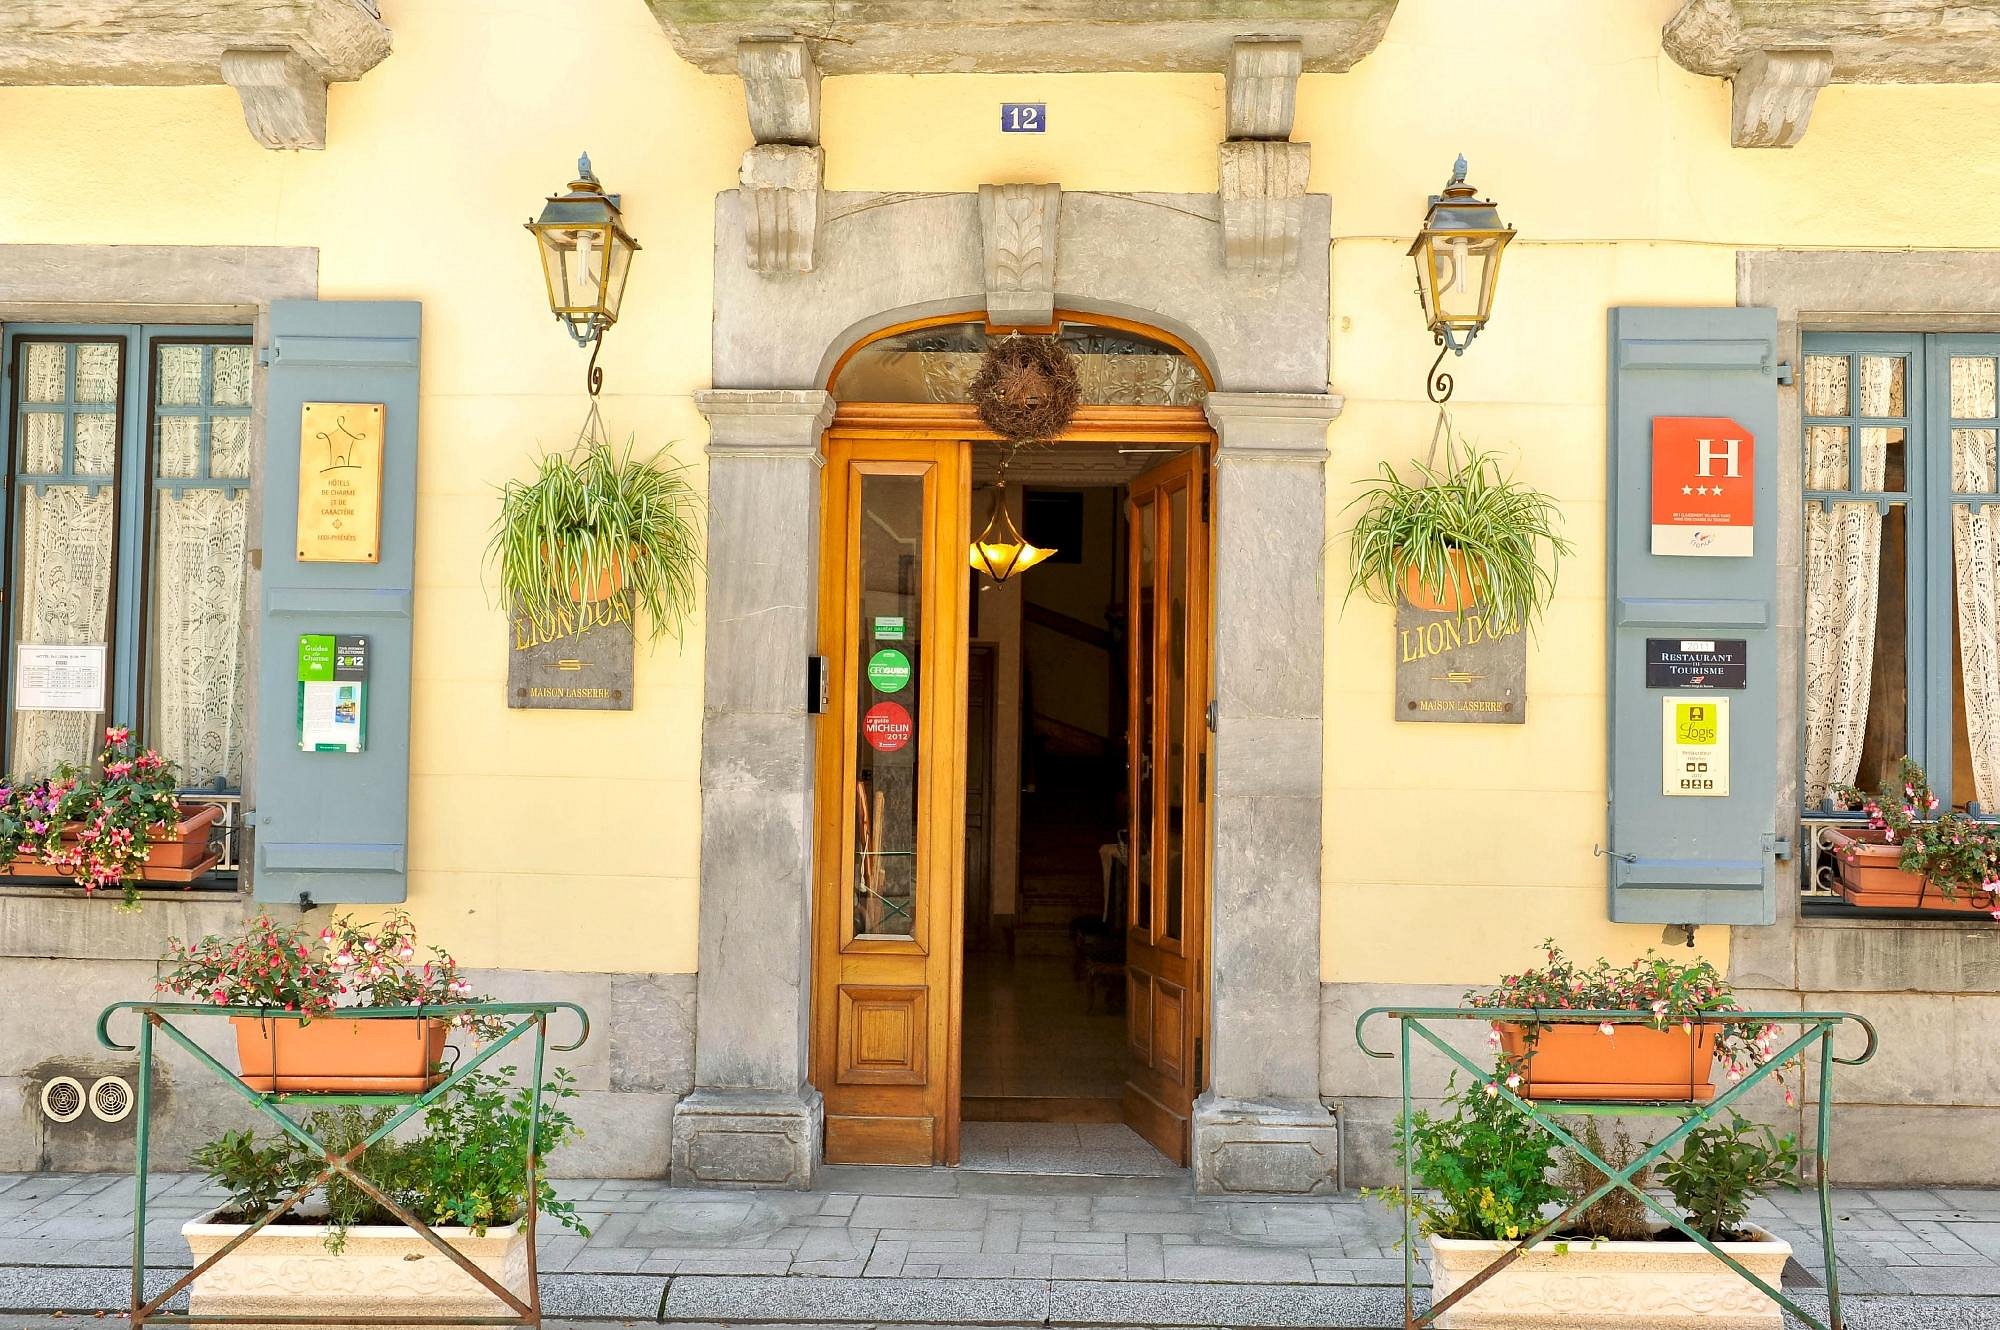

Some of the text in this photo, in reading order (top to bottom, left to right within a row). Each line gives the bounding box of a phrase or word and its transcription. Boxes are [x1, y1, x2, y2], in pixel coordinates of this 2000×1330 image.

[1010, 107, 1038, 129] 12
[1695, 438, 1743, 478] H
[515, 605, 574, 650] LION
[1401, 616, 1462, 663] LION
[1661, 652, 1733, 662] RESTAURANT
[1669, 665, 1725, 675] TOURISME
[530, 687, 610, 699] MAISON LASSERRE
[1420, 700, 1503, 712] MAISON LASSERRE
[866, 723, 909, 732] MICHELIN
[1679, 721, 1714, 742] Logis
